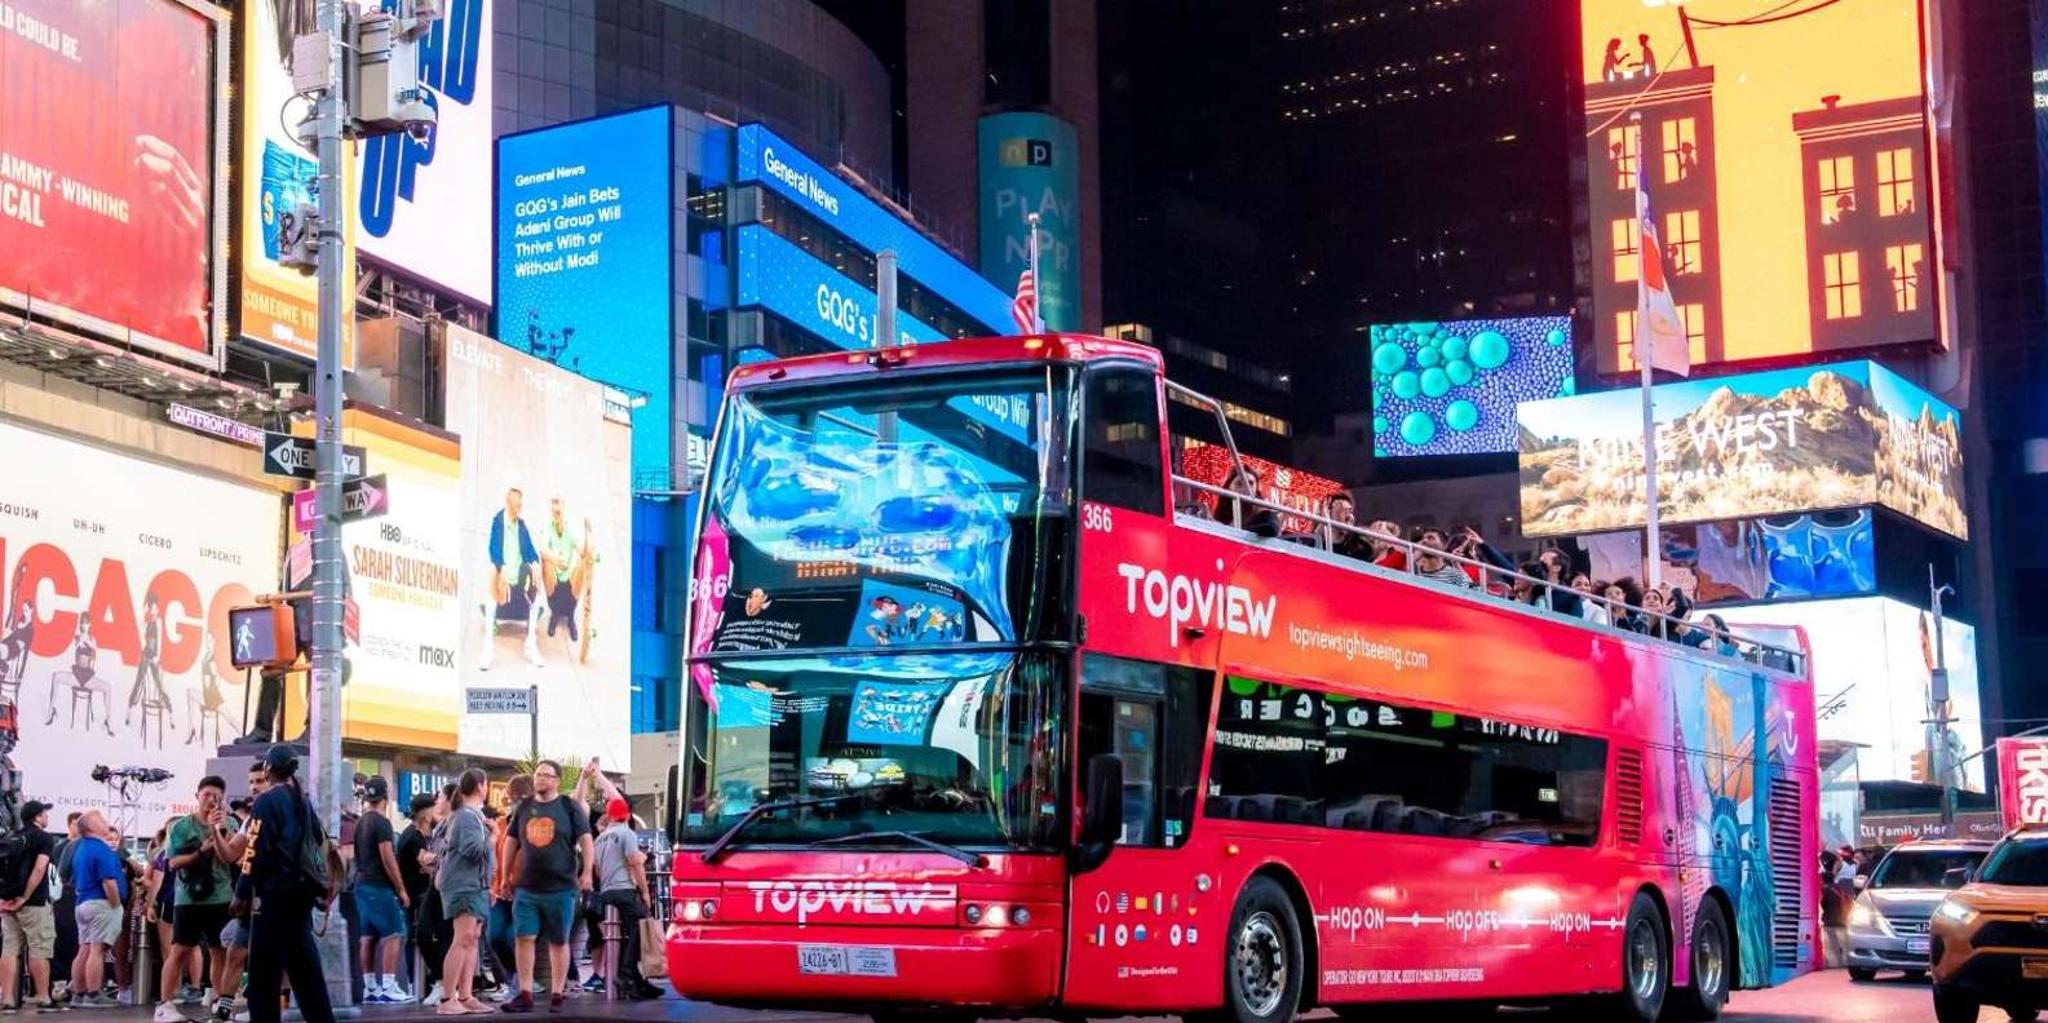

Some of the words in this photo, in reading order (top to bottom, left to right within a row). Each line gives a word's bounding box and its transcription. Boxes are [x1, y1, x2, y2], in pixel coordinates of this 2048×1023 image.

[17, 11, 59, 51] COULD
[515, 169, 555, 187] General
[557, 164, 586, 179] News
[764, 147, 809, 195] General
[810, 172, 838, 217] News
[0, 180, 44, 227] CAL
[515, 198, 557, 217] GQG's
[561, 193, 586, 209] Jain
[589, 186, 620, 204] Bets
[515, 220, 551, 238] Adani
[554, 212, 595, 231] Group
[598, 205, 621, 222] Will
[515, 240, 553, 258] Thrive
[557, 234, 585, 250] With
[589, 232, 603, 245] or
[515, 258, 563, 278] Without
[567, 250, 599, 269] Modi
[817, 283, 868, 343] GQG's
[452, 339, 504, 376] ELEVATE
[1579, 424, 1675, 470] NIE
[1688, 408, 1804, 456] WEST
[281, 447, 309, 467] ONE
[345, 489, 371, 510] WAY
[73, 518, 105, 534] UH-UH
[380, 522, 401, 543] HBO
[1083, 504, 1113, 533] 366
[138, 533, 173, 549] CICERO
[353, 544, 392, 583] SARAH
[395, 555, 459, 597] SILVERMAN
[0, 535, 260, 685] CAGO
[419, 643, 455, 669] max
[1289, 622, 1428, 671] topviewsightseeing.com
[1878, 825, 1921, 837] Family
[1365, 907, 1385, 929] ON
[1475, 910, 1498, 929] OFF
[1574, 912, 1590, 930] ON
